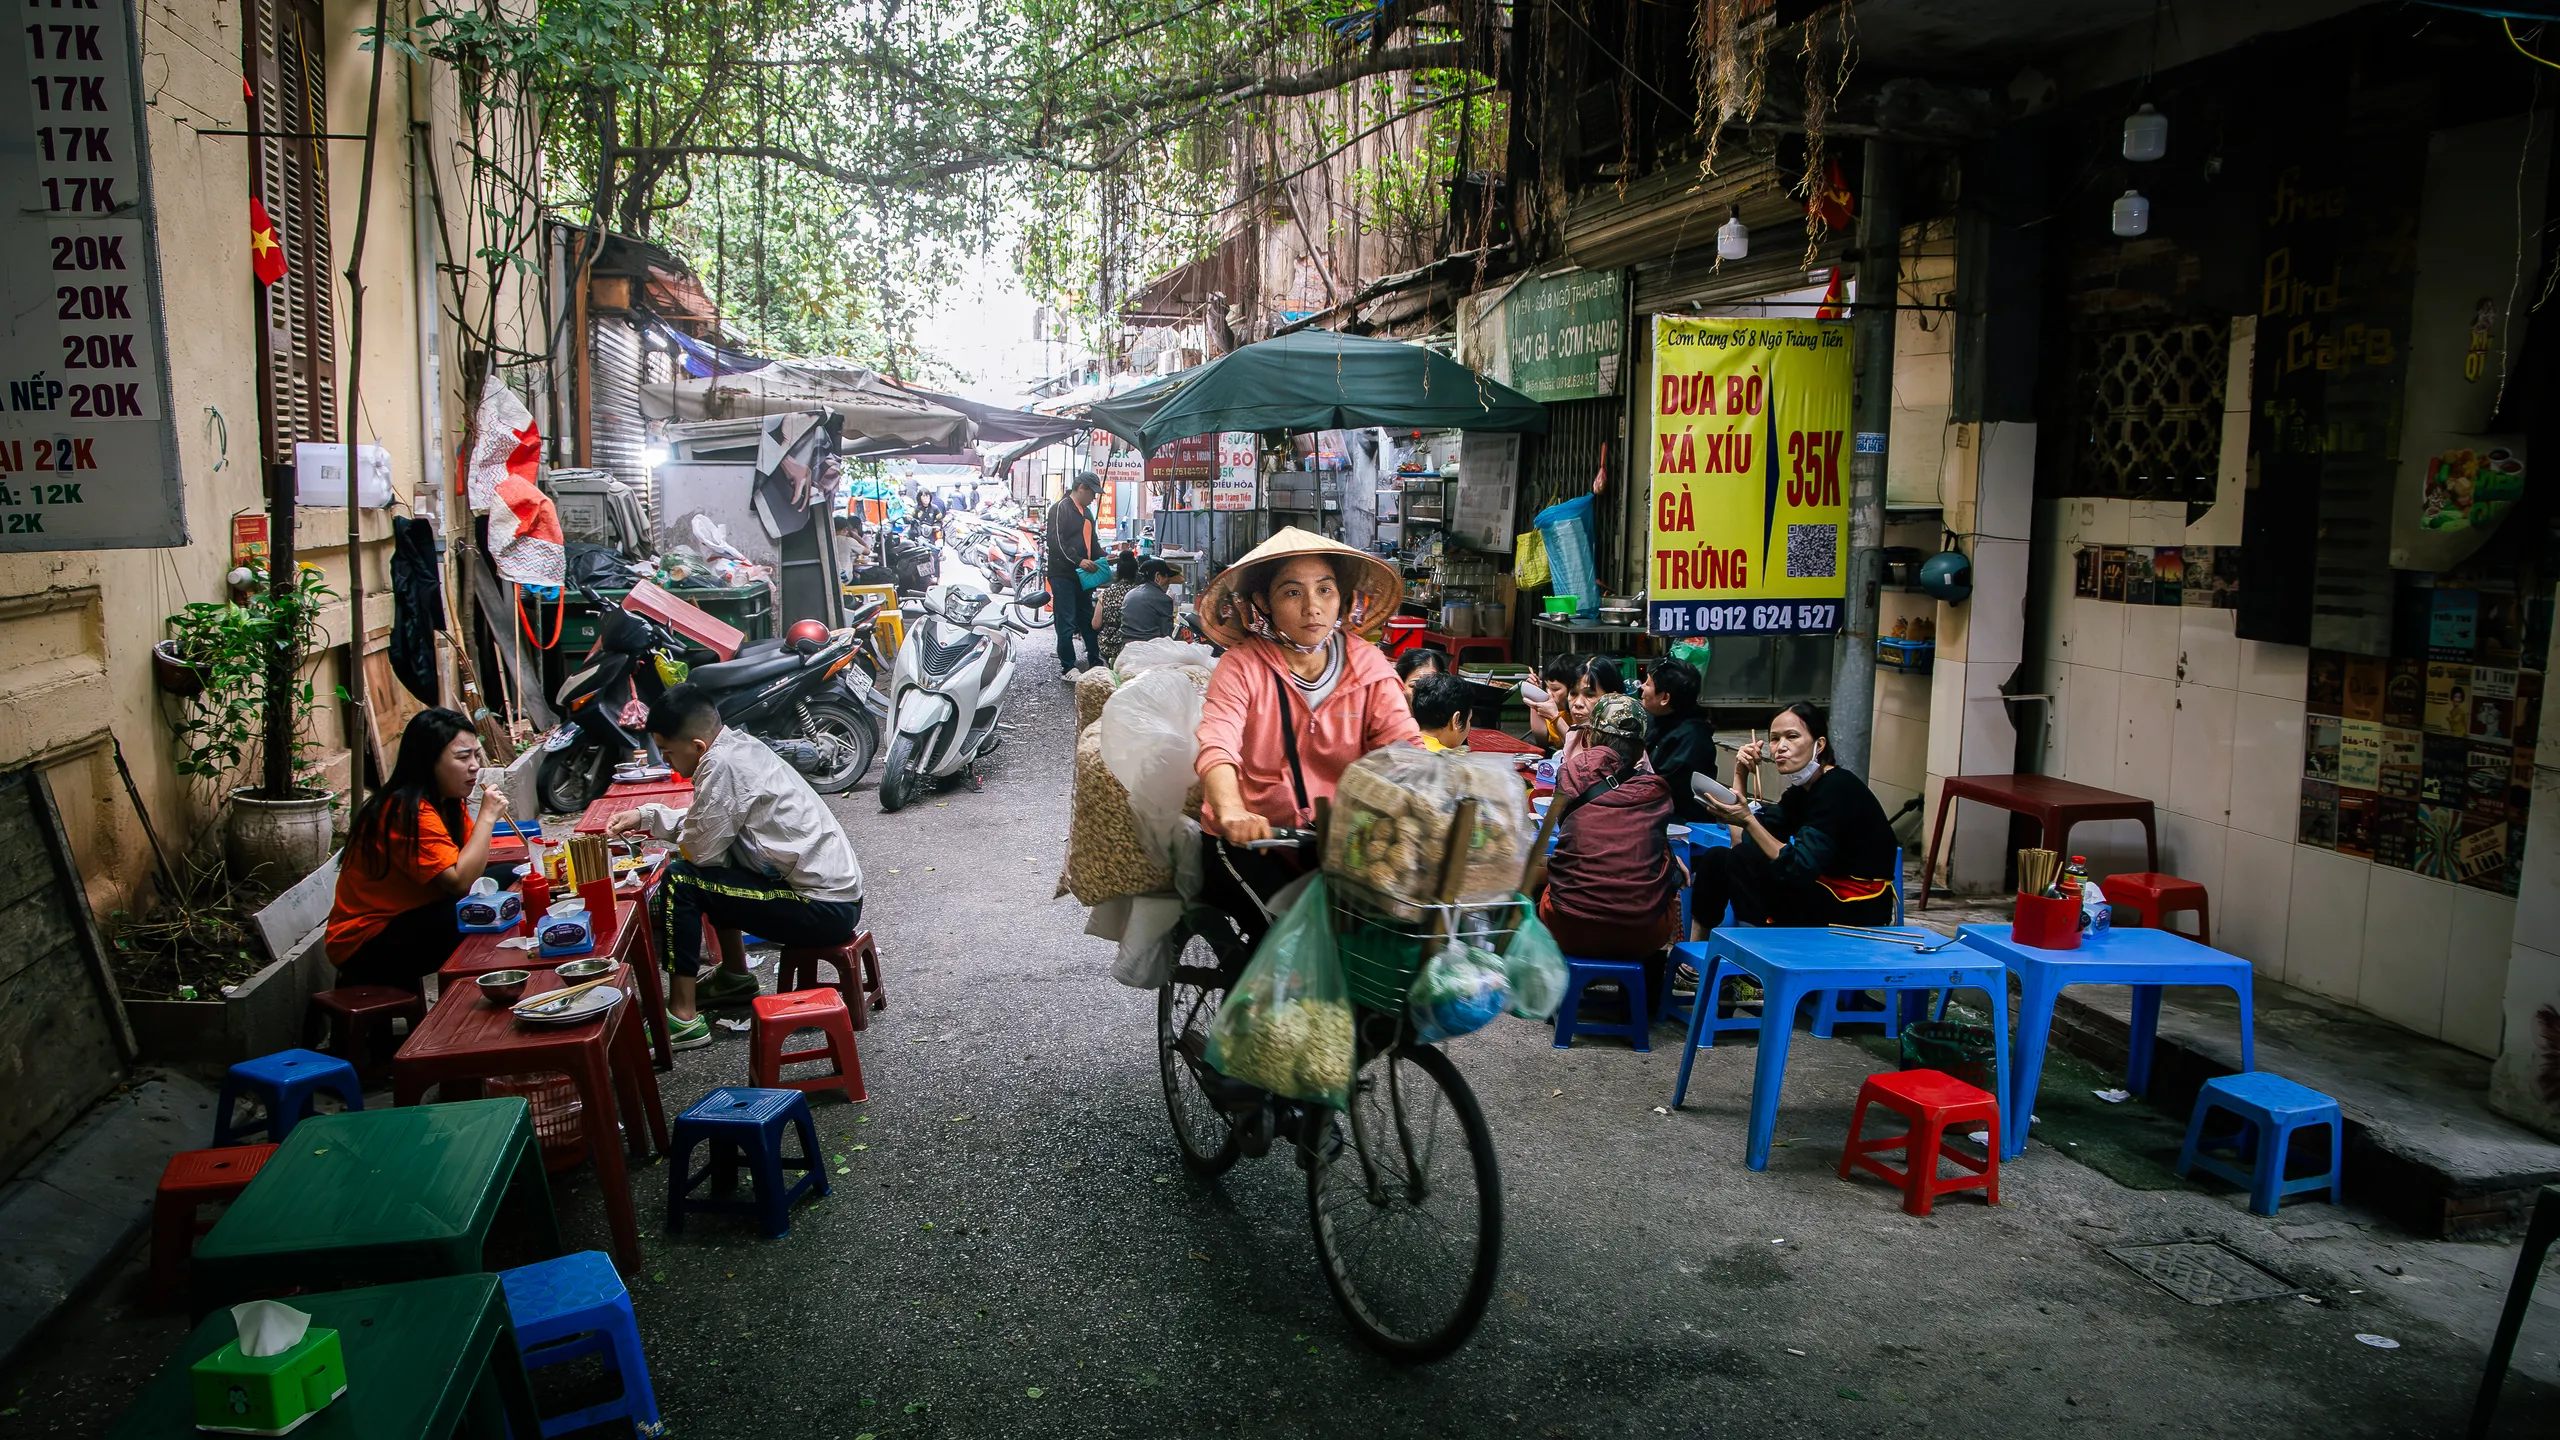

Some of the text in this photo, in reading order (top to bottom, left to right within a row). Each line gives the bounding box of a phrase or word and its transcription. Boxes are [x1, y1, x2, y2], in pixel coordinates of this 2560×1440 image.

[26, 24, 103, 60] 17K
[31, 76, 108, 111] 17K
[37, 127, 113, 162] 17K
[42, 178, 116, 211] 17K
[51, 236, 126, 270] 20K
[2262, 246, 2348, 318] Bird
[57, 286, 132, 320] 20K
[1547, 293, 1553, 309] 8
[63, 335, 137, 369] 20K
[1535, 325, 1549, 362] GÀ
[1558, 326, 1583, 358] CƠM
[1586, 318, 1618, 353] RANG
[1697, 330, 1728, 350] Rang
[1731, 328, 1748, 347] Số
[1748, 330, 1756, 347] 8
[1759, 329, 1783, 350] Ngõ
[1786, 329, 1818, 350] Tràng
[10, 371, 63, 411] NẾP
[69, 383, 142, 417] 20K
[1661, 370, 1717, 415] DƯA
[1726, 365, 1763, 415] BÒ
[34, 438, 97, 471] 22K
[1233, 448, 1253, 467] BÒ
[1658, 425, 1752, 474] XÁ XÍU
[1787, 430, 1844, 507] 35K
[30, 484, 84, 504] 12K
[1658, 483, 1695, 532] GÀ
[0, 513, 44, 534] 2K
[1656, 541, 1748, 590] TRỨNG
[1659, 605, 1836, 631] ĐT: 0912 624 527
